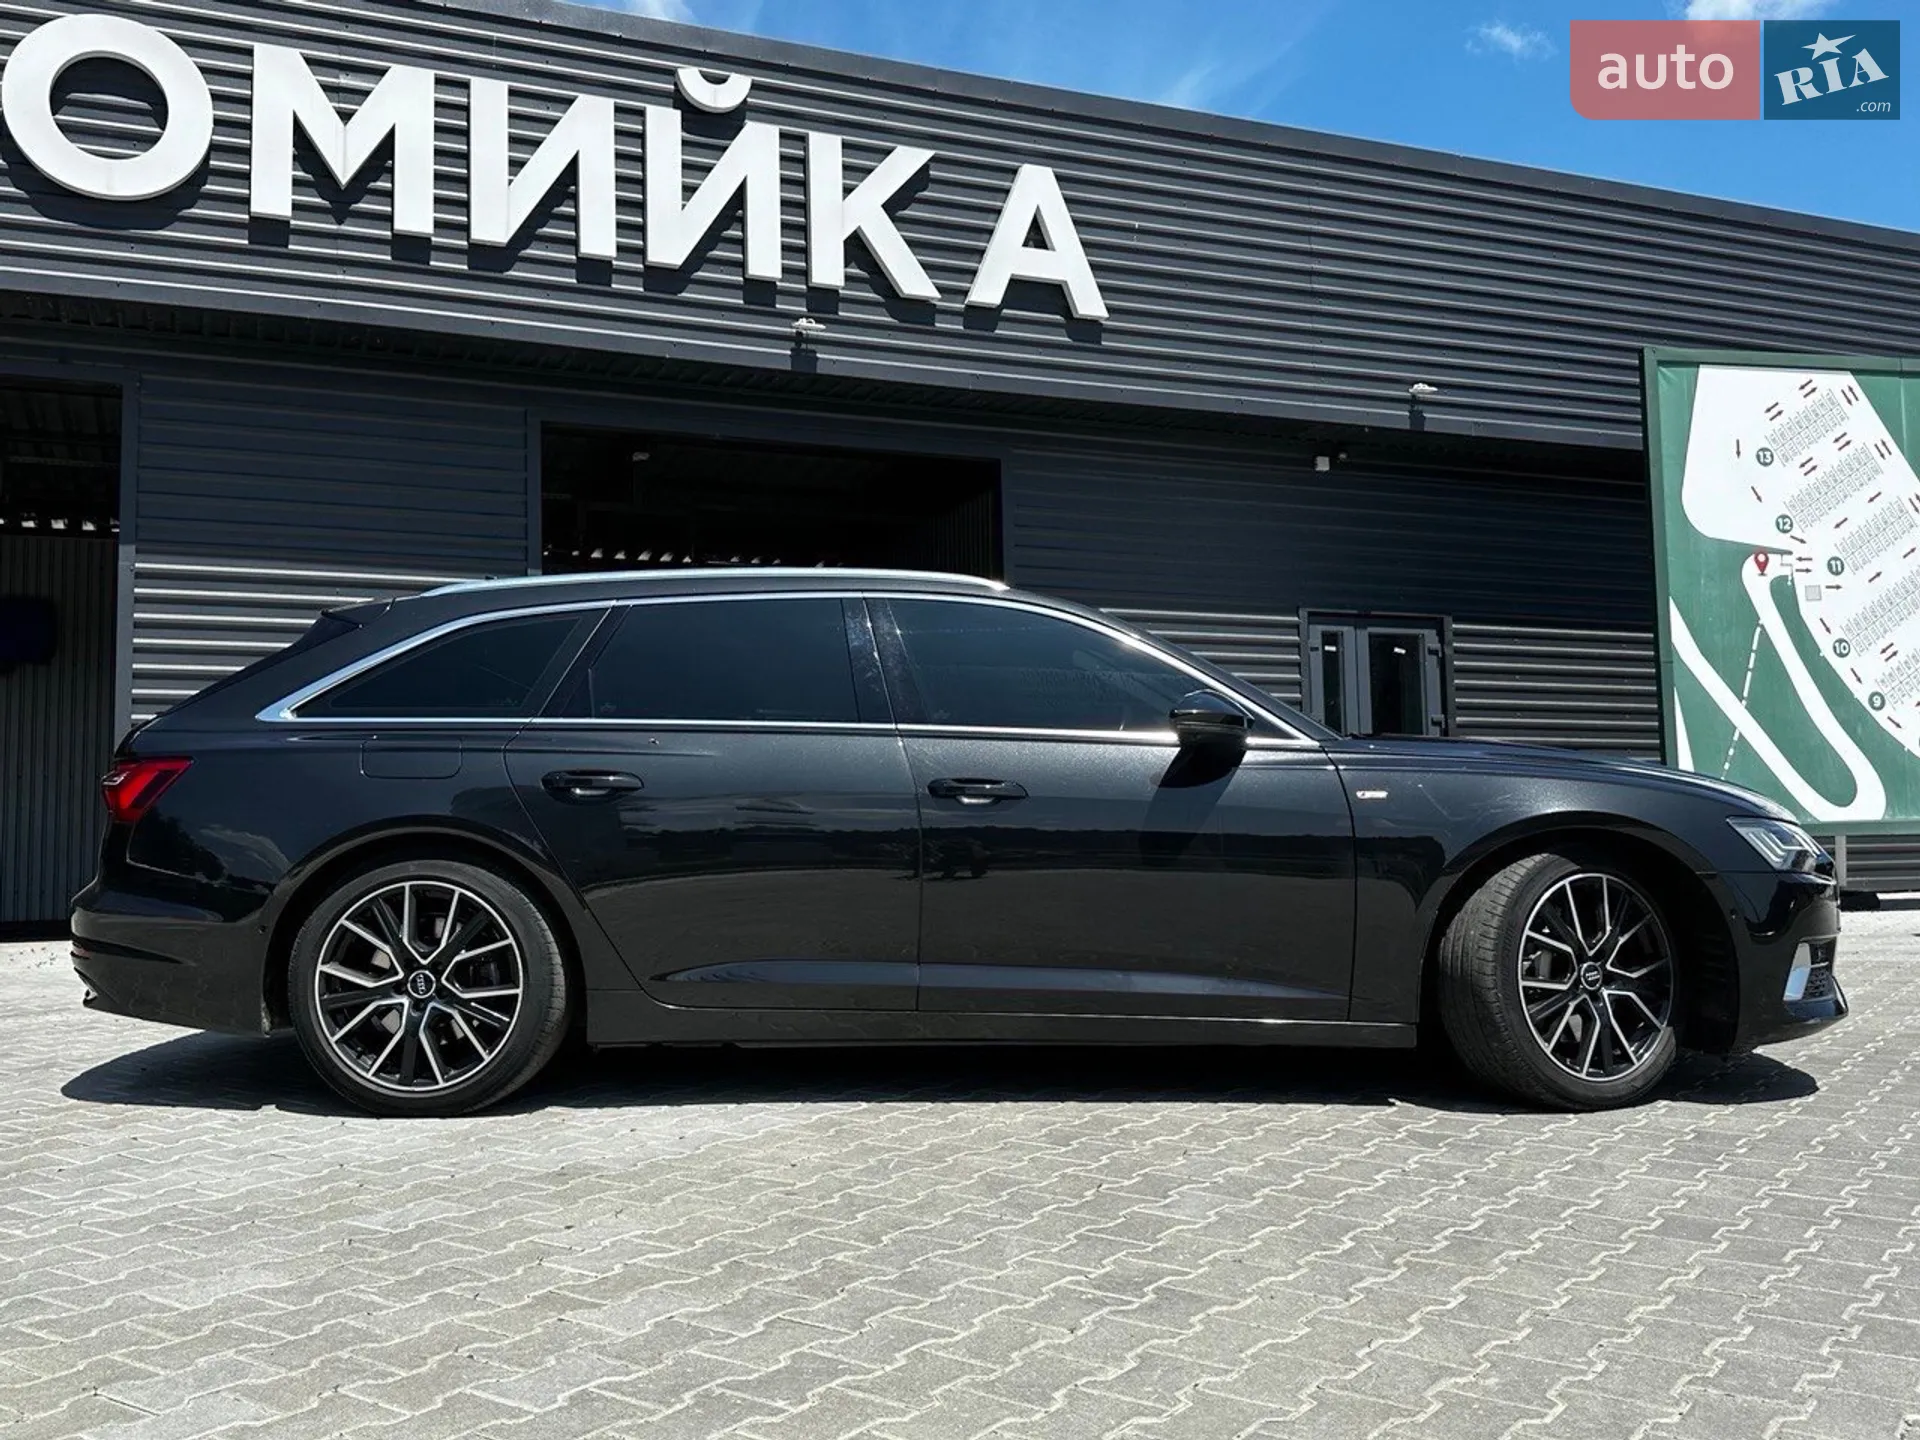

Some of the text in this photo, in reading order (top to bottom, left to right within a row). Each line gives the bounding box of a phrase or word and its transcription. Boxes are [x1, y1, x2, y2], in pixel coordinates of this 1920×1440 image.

[2, 14, 1109, 321] ОМИЙКА
[1758, 451, 1772, 463] 13
[1777, 518, 1791, 530] 12
[1830, 560, 1842, 573] 11
[1834, 642, 1849, 654] 10
[1872, 695, 1881, 707] 9
